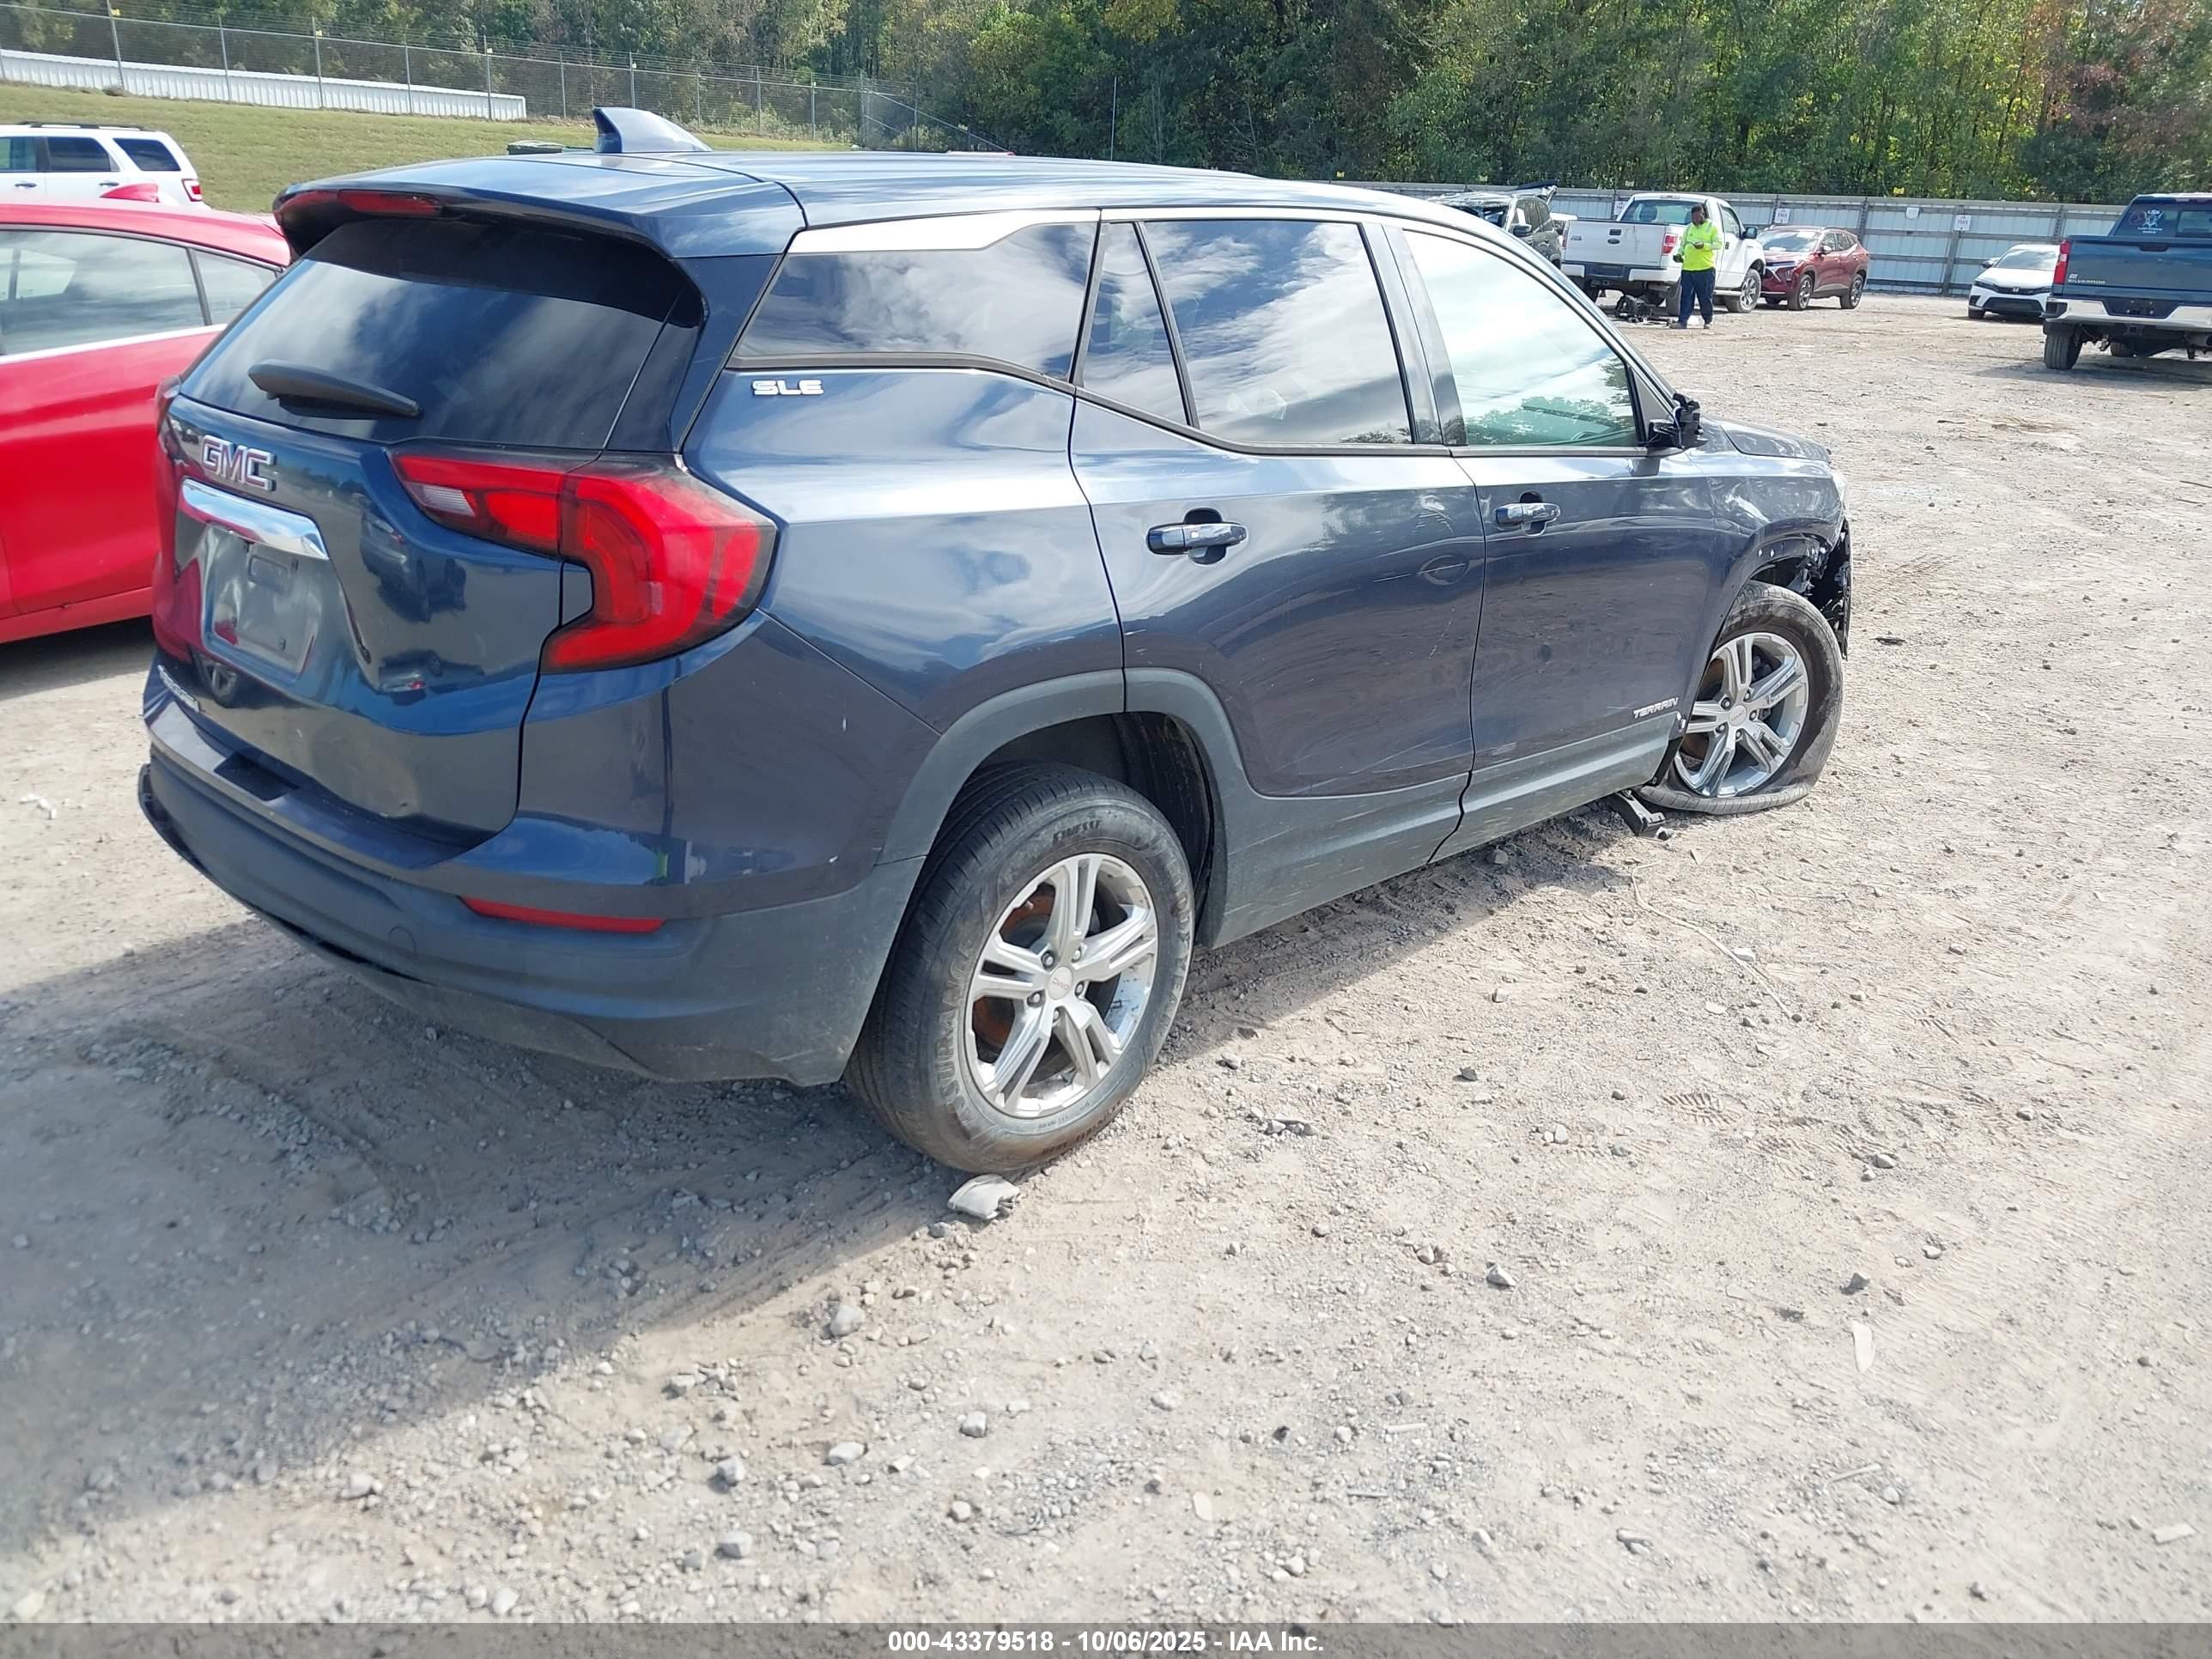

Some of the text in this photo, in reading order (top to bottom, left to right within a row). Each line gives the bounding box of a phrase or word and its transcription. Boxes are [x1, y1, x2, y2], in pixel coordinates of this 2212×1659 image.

[751, 380, 824, 396] SLE
[202, 434, 276, 491] GMC
[1633, 696, 1679, 719] TERRAIN
